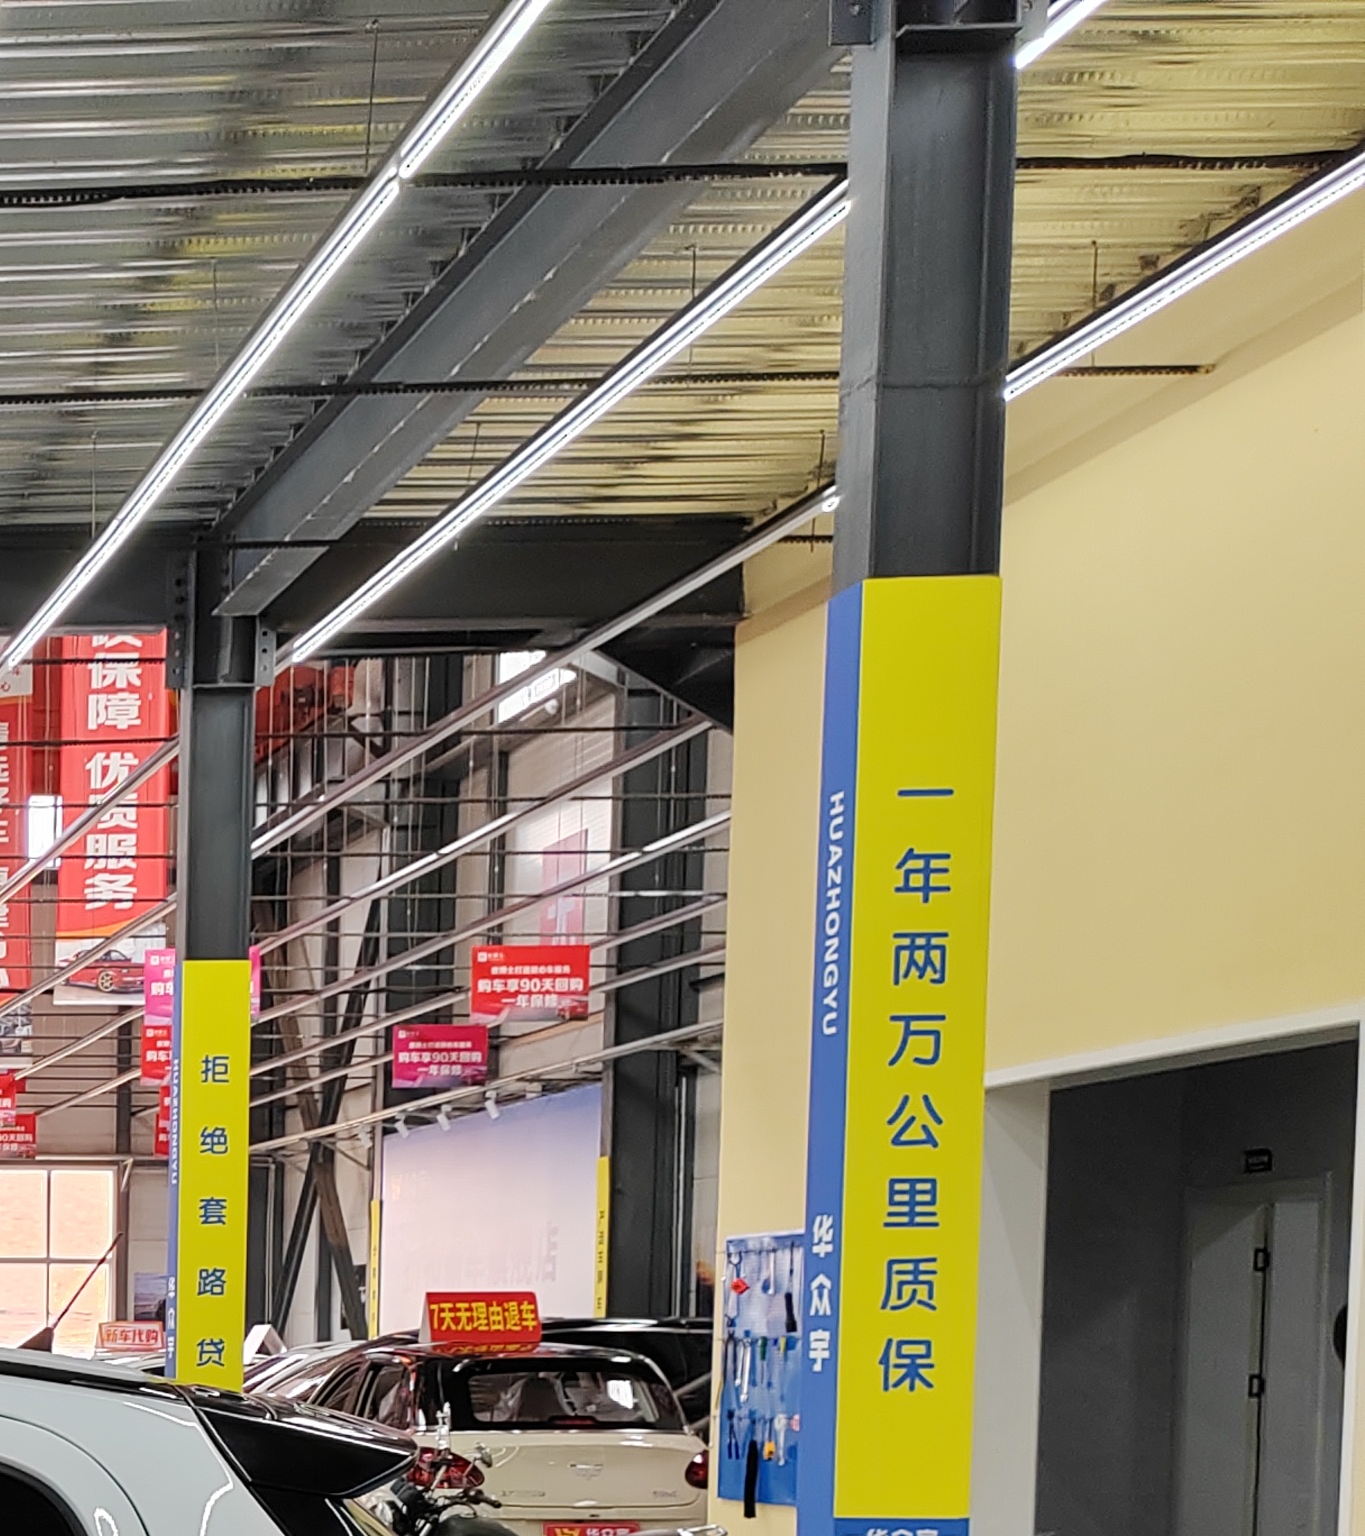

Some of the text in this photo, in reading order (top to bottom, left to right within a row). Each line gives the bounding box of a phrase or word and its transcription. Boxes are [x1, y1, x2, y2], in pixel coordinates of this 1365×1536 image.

[83, 751, 138, 911] 优质服务
[822, 791, 845, 1036] HUAZHONGYU
[477, 978, 584, 992] 购车享90天回购
[501, 994, 558, 1008] 一年保修
[398, 1051, 482, 1063] 购车享90天回购
[877, 788, 955, 1393] 一年两万公里质保
[196, 1054, 230, 1368] 拒绝套路贷
[105, 1328, 159, 1344] 新车代购
[429, 1300, 537, 1332] 7天无理由退车
[808, 1213, 833, 1373] 华众宇
